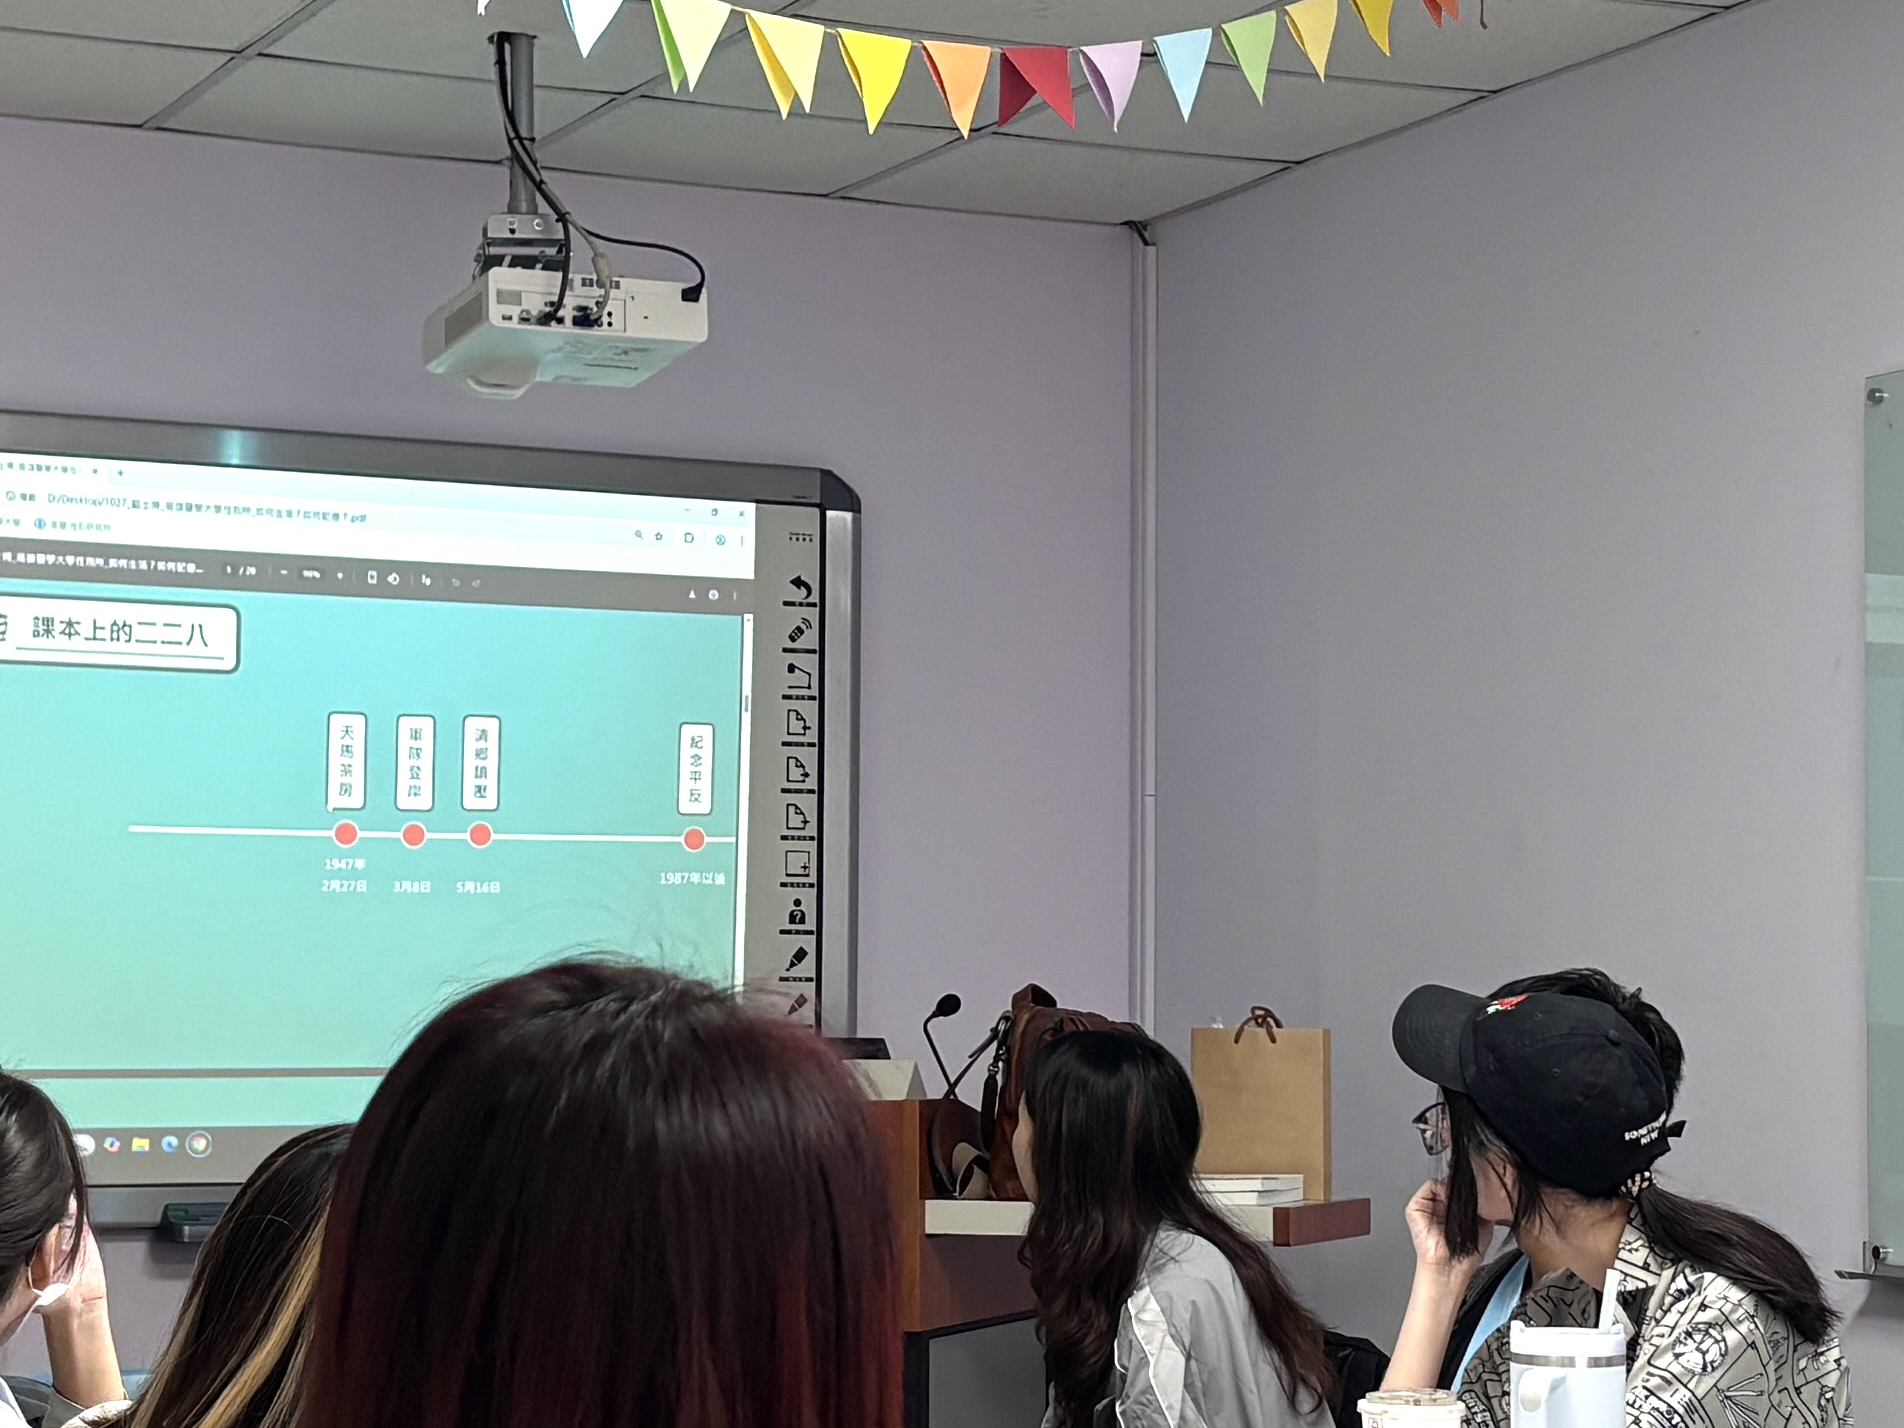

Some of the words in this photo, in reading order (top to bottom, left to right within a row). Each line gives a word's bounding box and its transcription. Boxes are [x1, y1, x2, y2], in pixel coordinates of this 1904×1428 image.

[32, 616, 208, 647] 課本上的二二八
[688, 734, 704, 804] 紀念平反
[325, 858, 366, 870] 1947年
[321, 879, 367, 893] 2月27日
[392, 880, 432, 894] 3月8日
[456, 881, 501, 895] 5月16日
